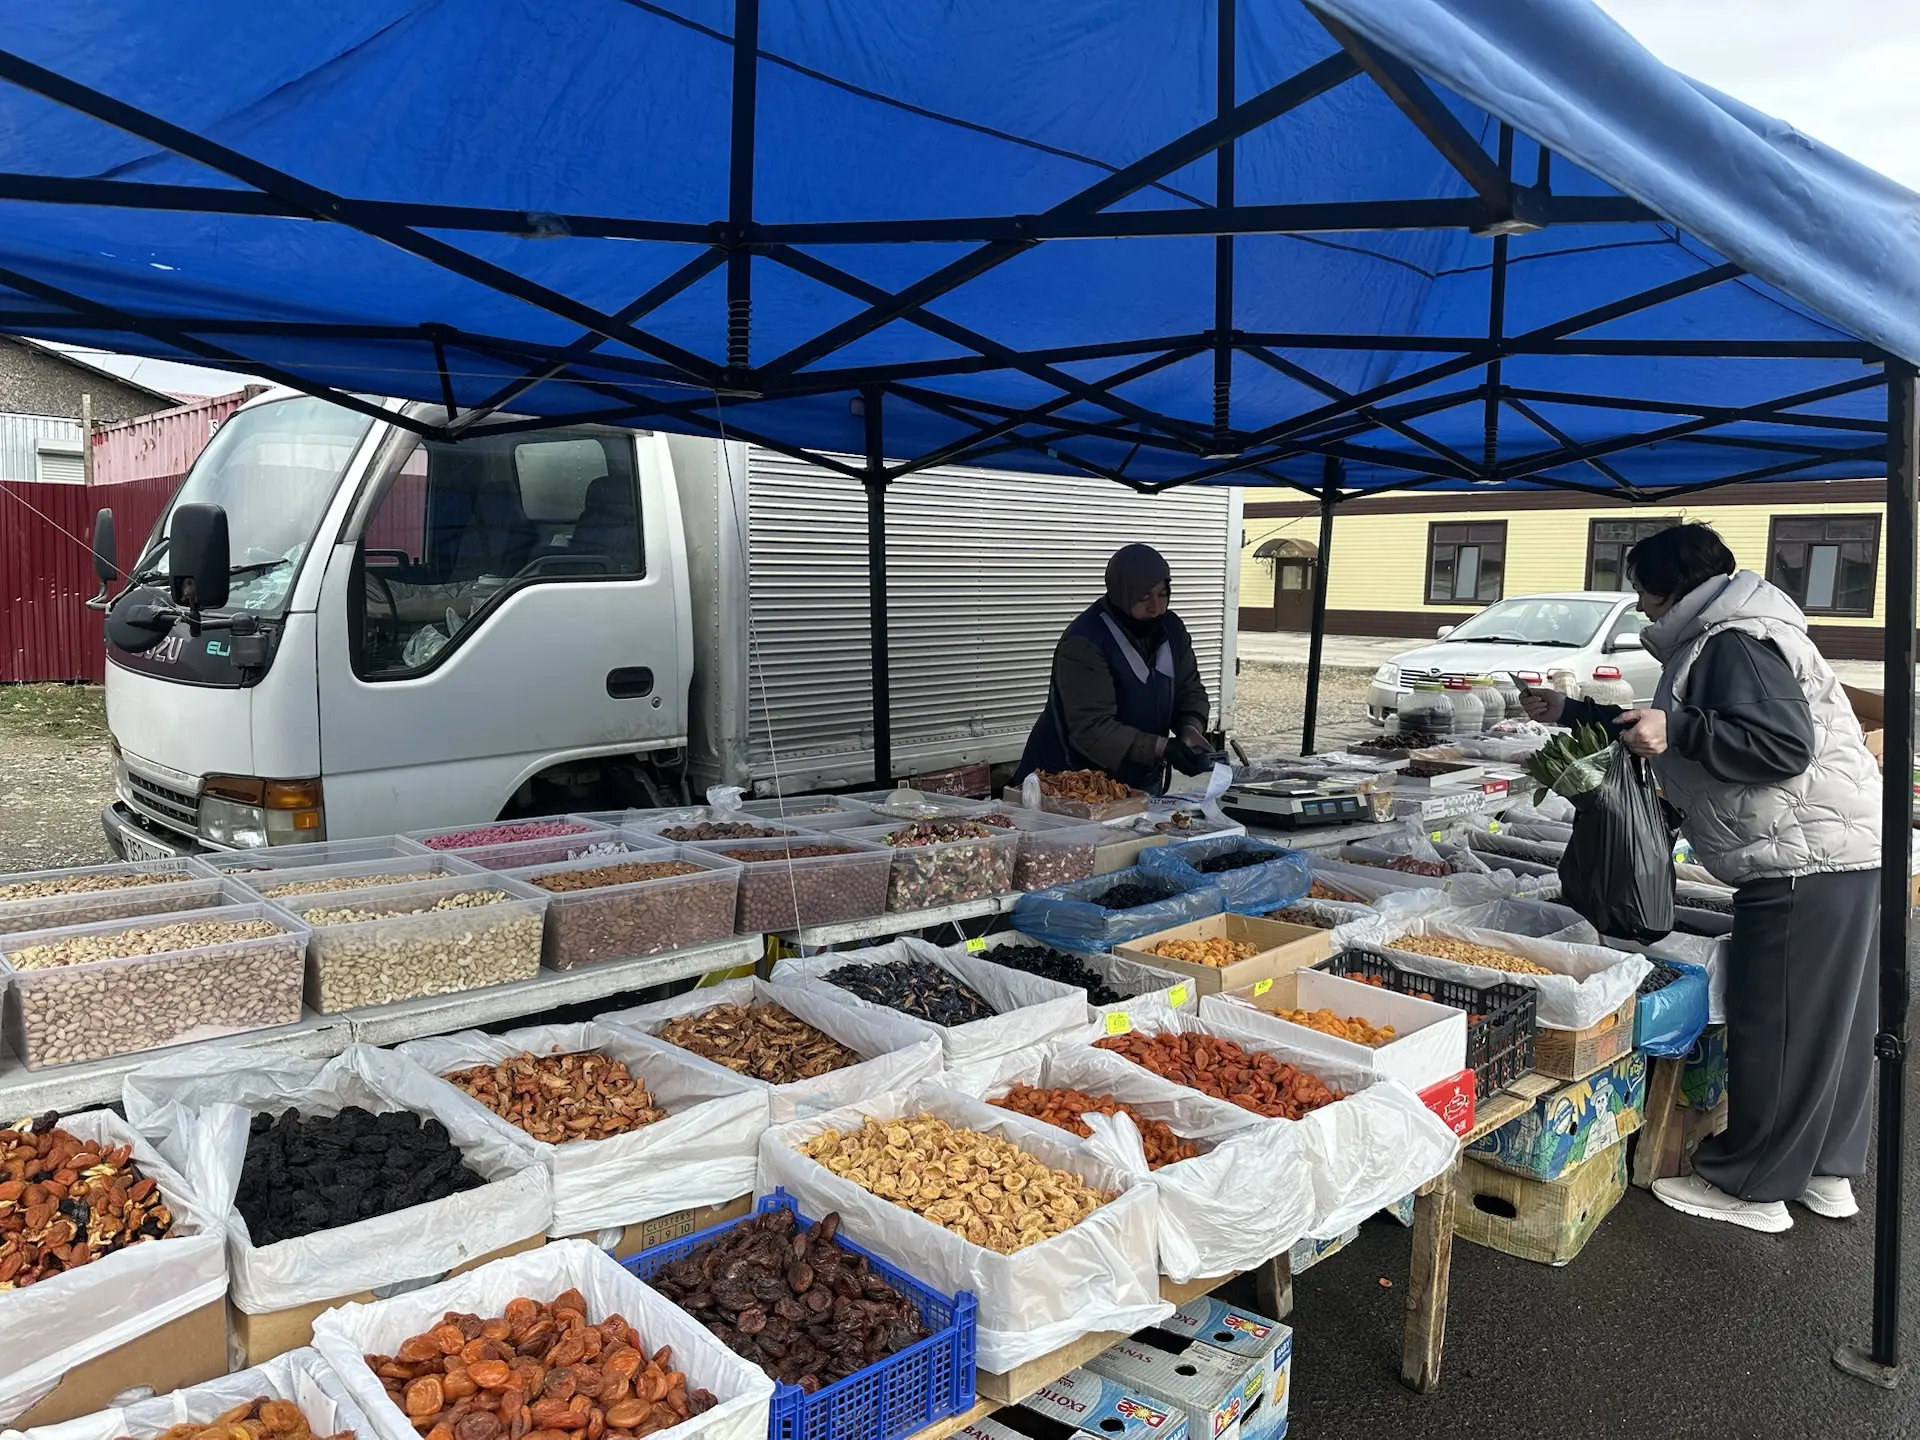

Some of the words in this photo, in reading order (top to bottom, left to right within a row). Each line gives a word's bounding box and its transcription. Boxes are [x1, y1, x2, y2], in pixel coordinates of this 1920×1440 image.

[206, 640, 231, 657] EL
[645, 1211, 691, 1233] CLUSTERS
[648, 1235, 655, 1246] 8
[665, 1229, 671, 1240] 9
[680, 1223, 690, 1234] 10
[1222, 1314, 1273, 1340] Dole
[1115, 1398, 1168, 1429] Dole
[1215, 1397, 1241, 1436] Dole
